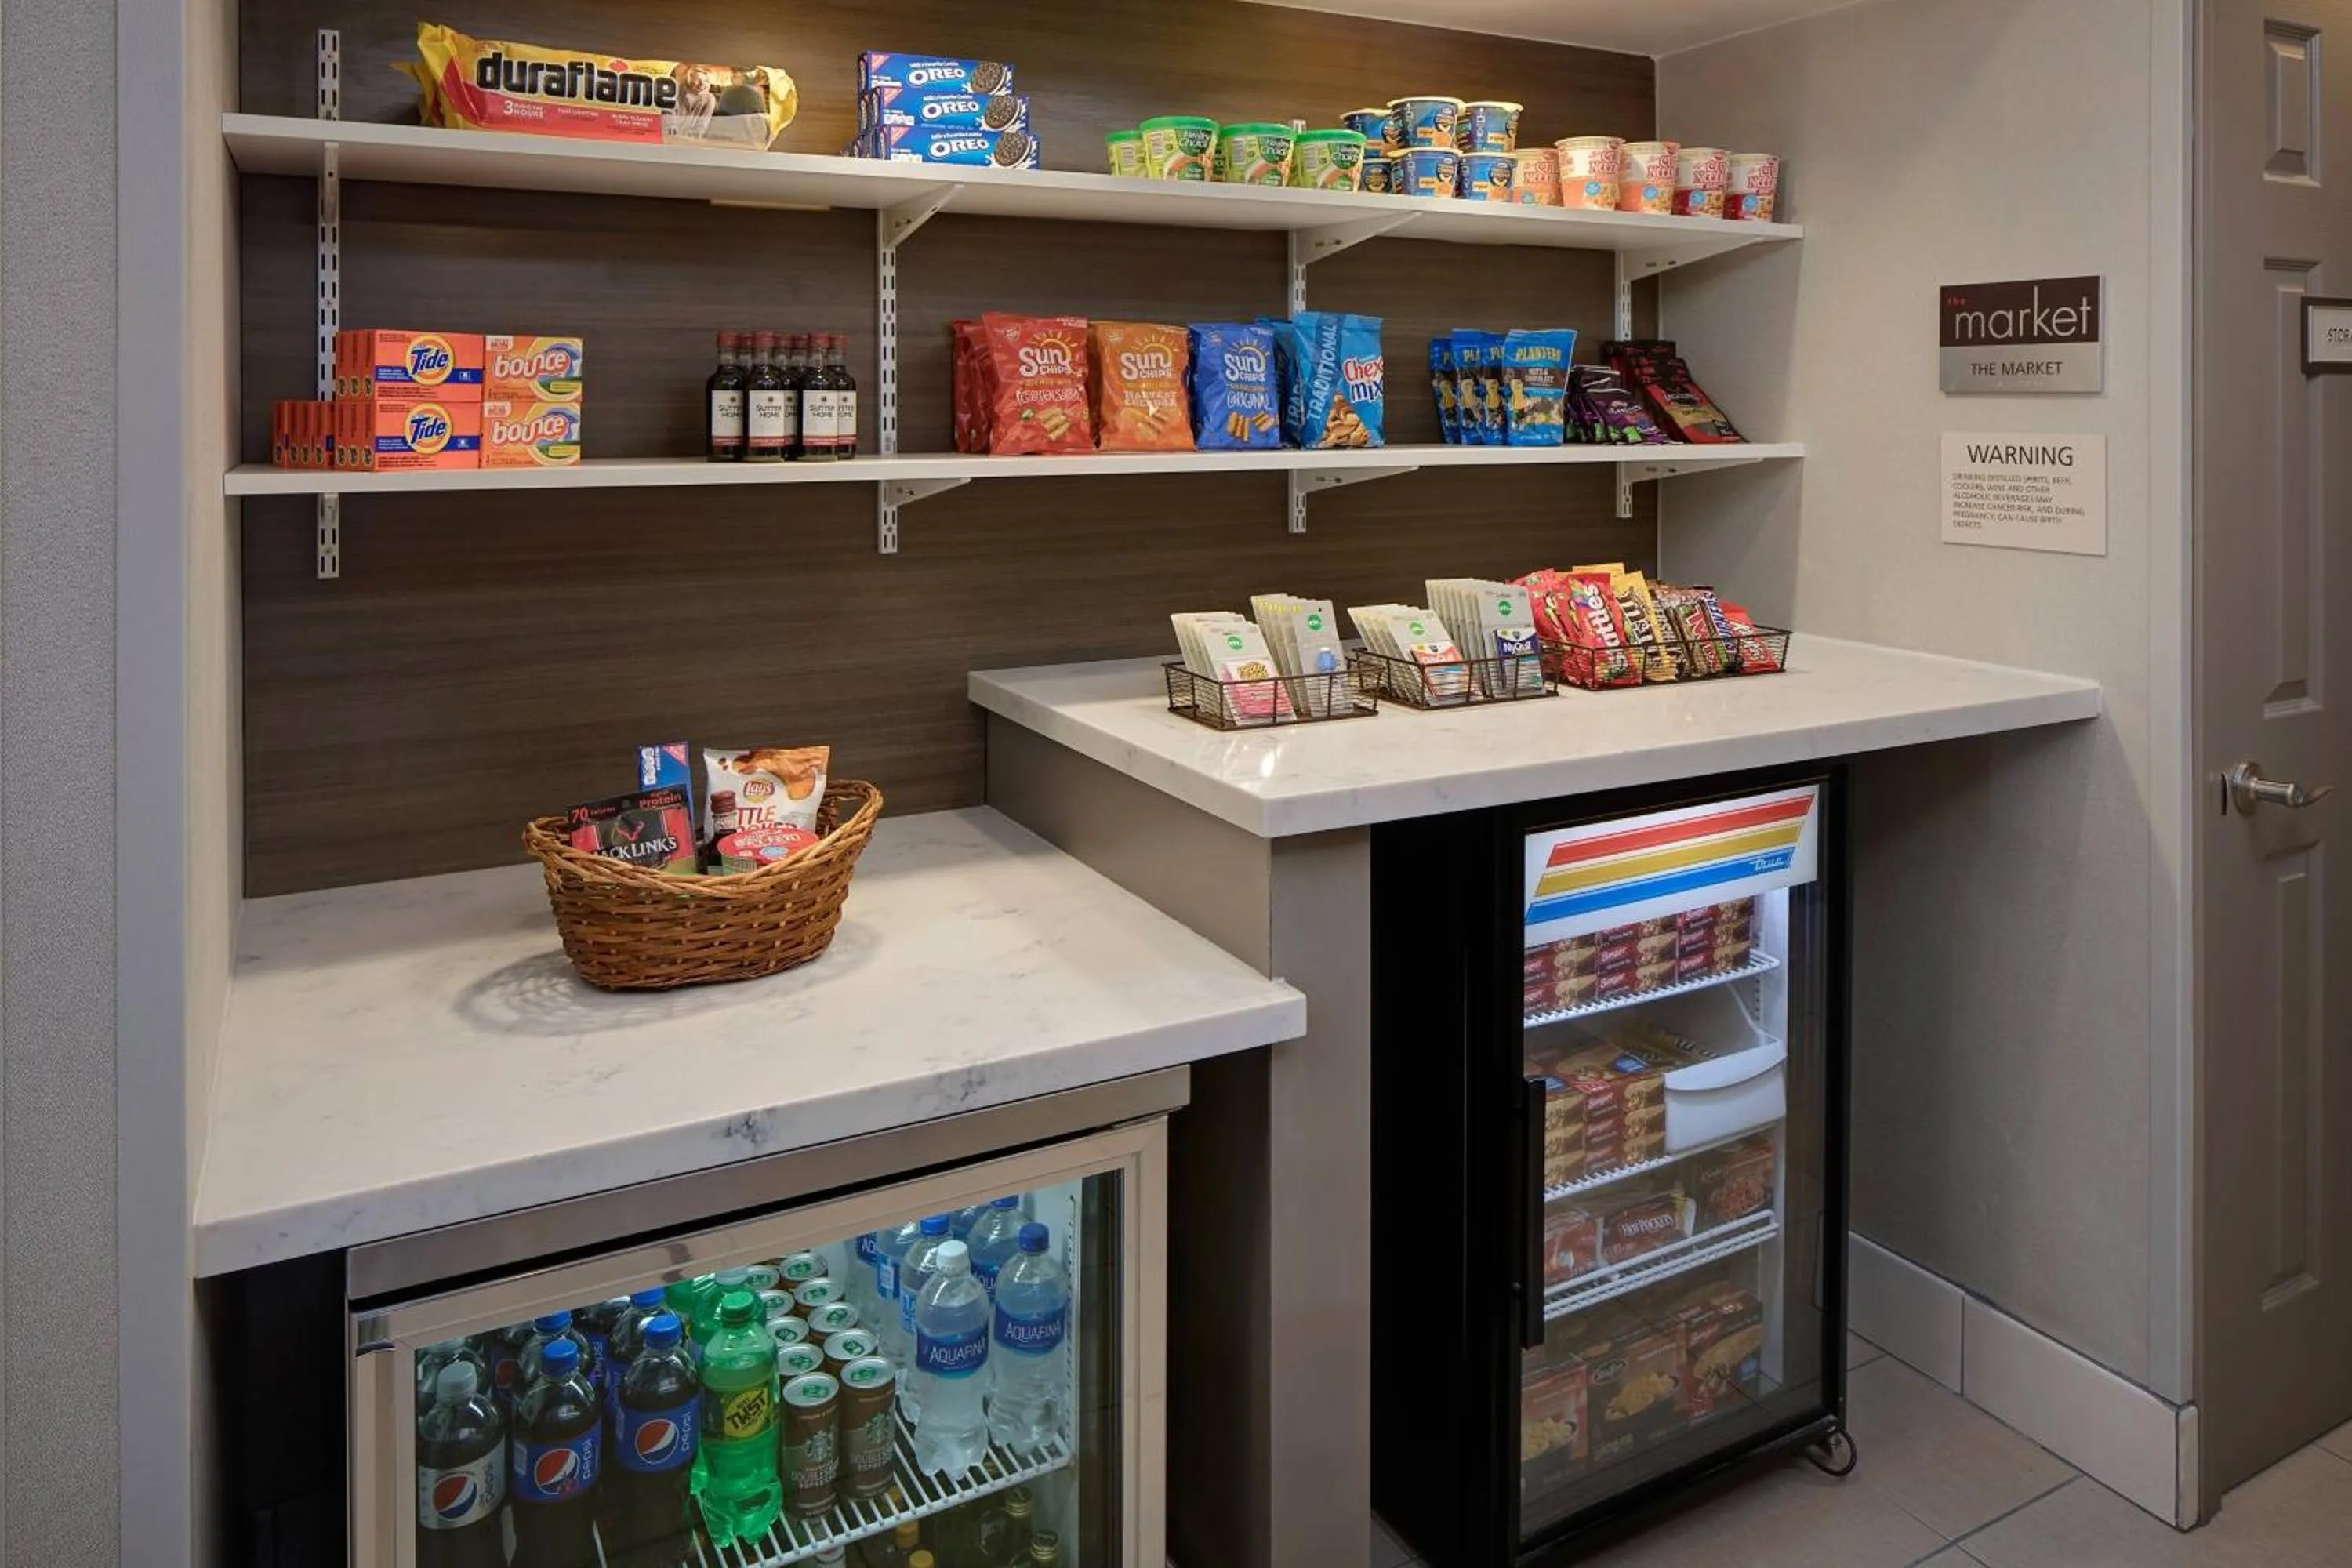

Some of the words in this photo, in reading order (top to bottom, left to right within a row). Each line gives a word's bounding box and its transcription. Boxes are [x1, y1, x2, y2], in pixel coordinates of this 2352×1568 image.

[477, 52, 677, 110] duraflame
[908, 66, 966, 85] OREO
[503, 100, 514, 115] 3
[921, 100, 980, 119] OREO
[930, 138, 989, 158] OREO
[1955, 285, 2092, 339] market
[2327, 328, 2352, 343] STOR
[410, 347, 449, 376] Tide
[493, 350, 568, 378] bounce
[1019, 347, 1072, 377] Sun
[1039, 364, 1073, 375] CHIPS
[1120, 352, 1172, 380] Sun
[1139, 368, 1172, 379] CHIPS
[1224, 353, 1265, 382] Sun
[1307, 325, 1338, 420] TRADITIONAL
[1343, 358, 1383, 383] Chex
[1970, 363, 1996, 376] THE
[2001, 361, 2063, 376] MARKET
[410, 416, 447, 445] Tide
[491, 413, 565, 445] bounce
[1966, 444, 2074, 467] WARNING
[639, 793, 682, 810] Protein
[571, 807, 589, 824] 70
[736, 805, 777, 826] TTLE
[1006, 1321, 1061, 1343] AQUAFINA
[929, 1336, 986, 1366] AQUAFINA
[681, 1411, 692, 1452] pepsi
[583, 1440, 593, 1480] pepsi
